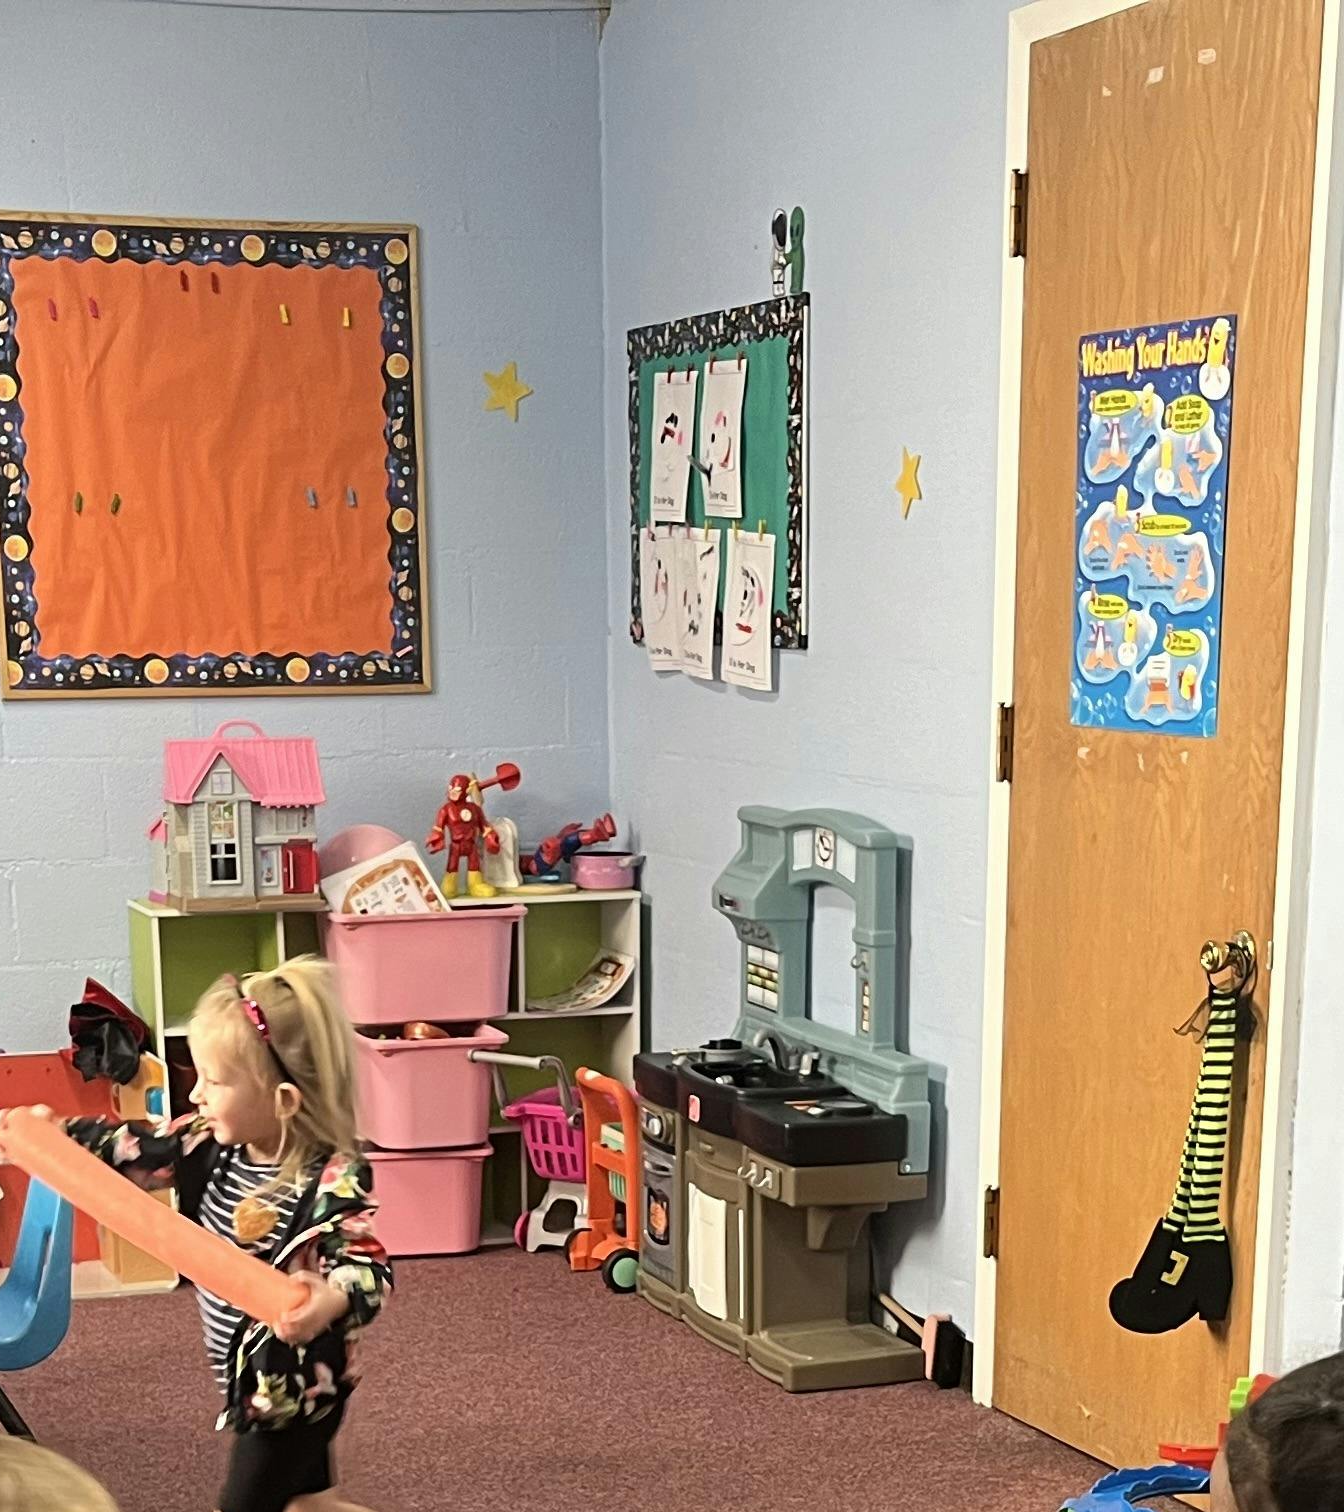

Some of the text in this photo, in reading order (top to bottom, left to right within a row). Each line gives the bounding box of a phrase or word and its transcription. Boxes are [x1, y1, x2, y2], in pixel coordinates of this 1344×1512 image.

[1081, 327, 1207, 381] Washing Your Hands
